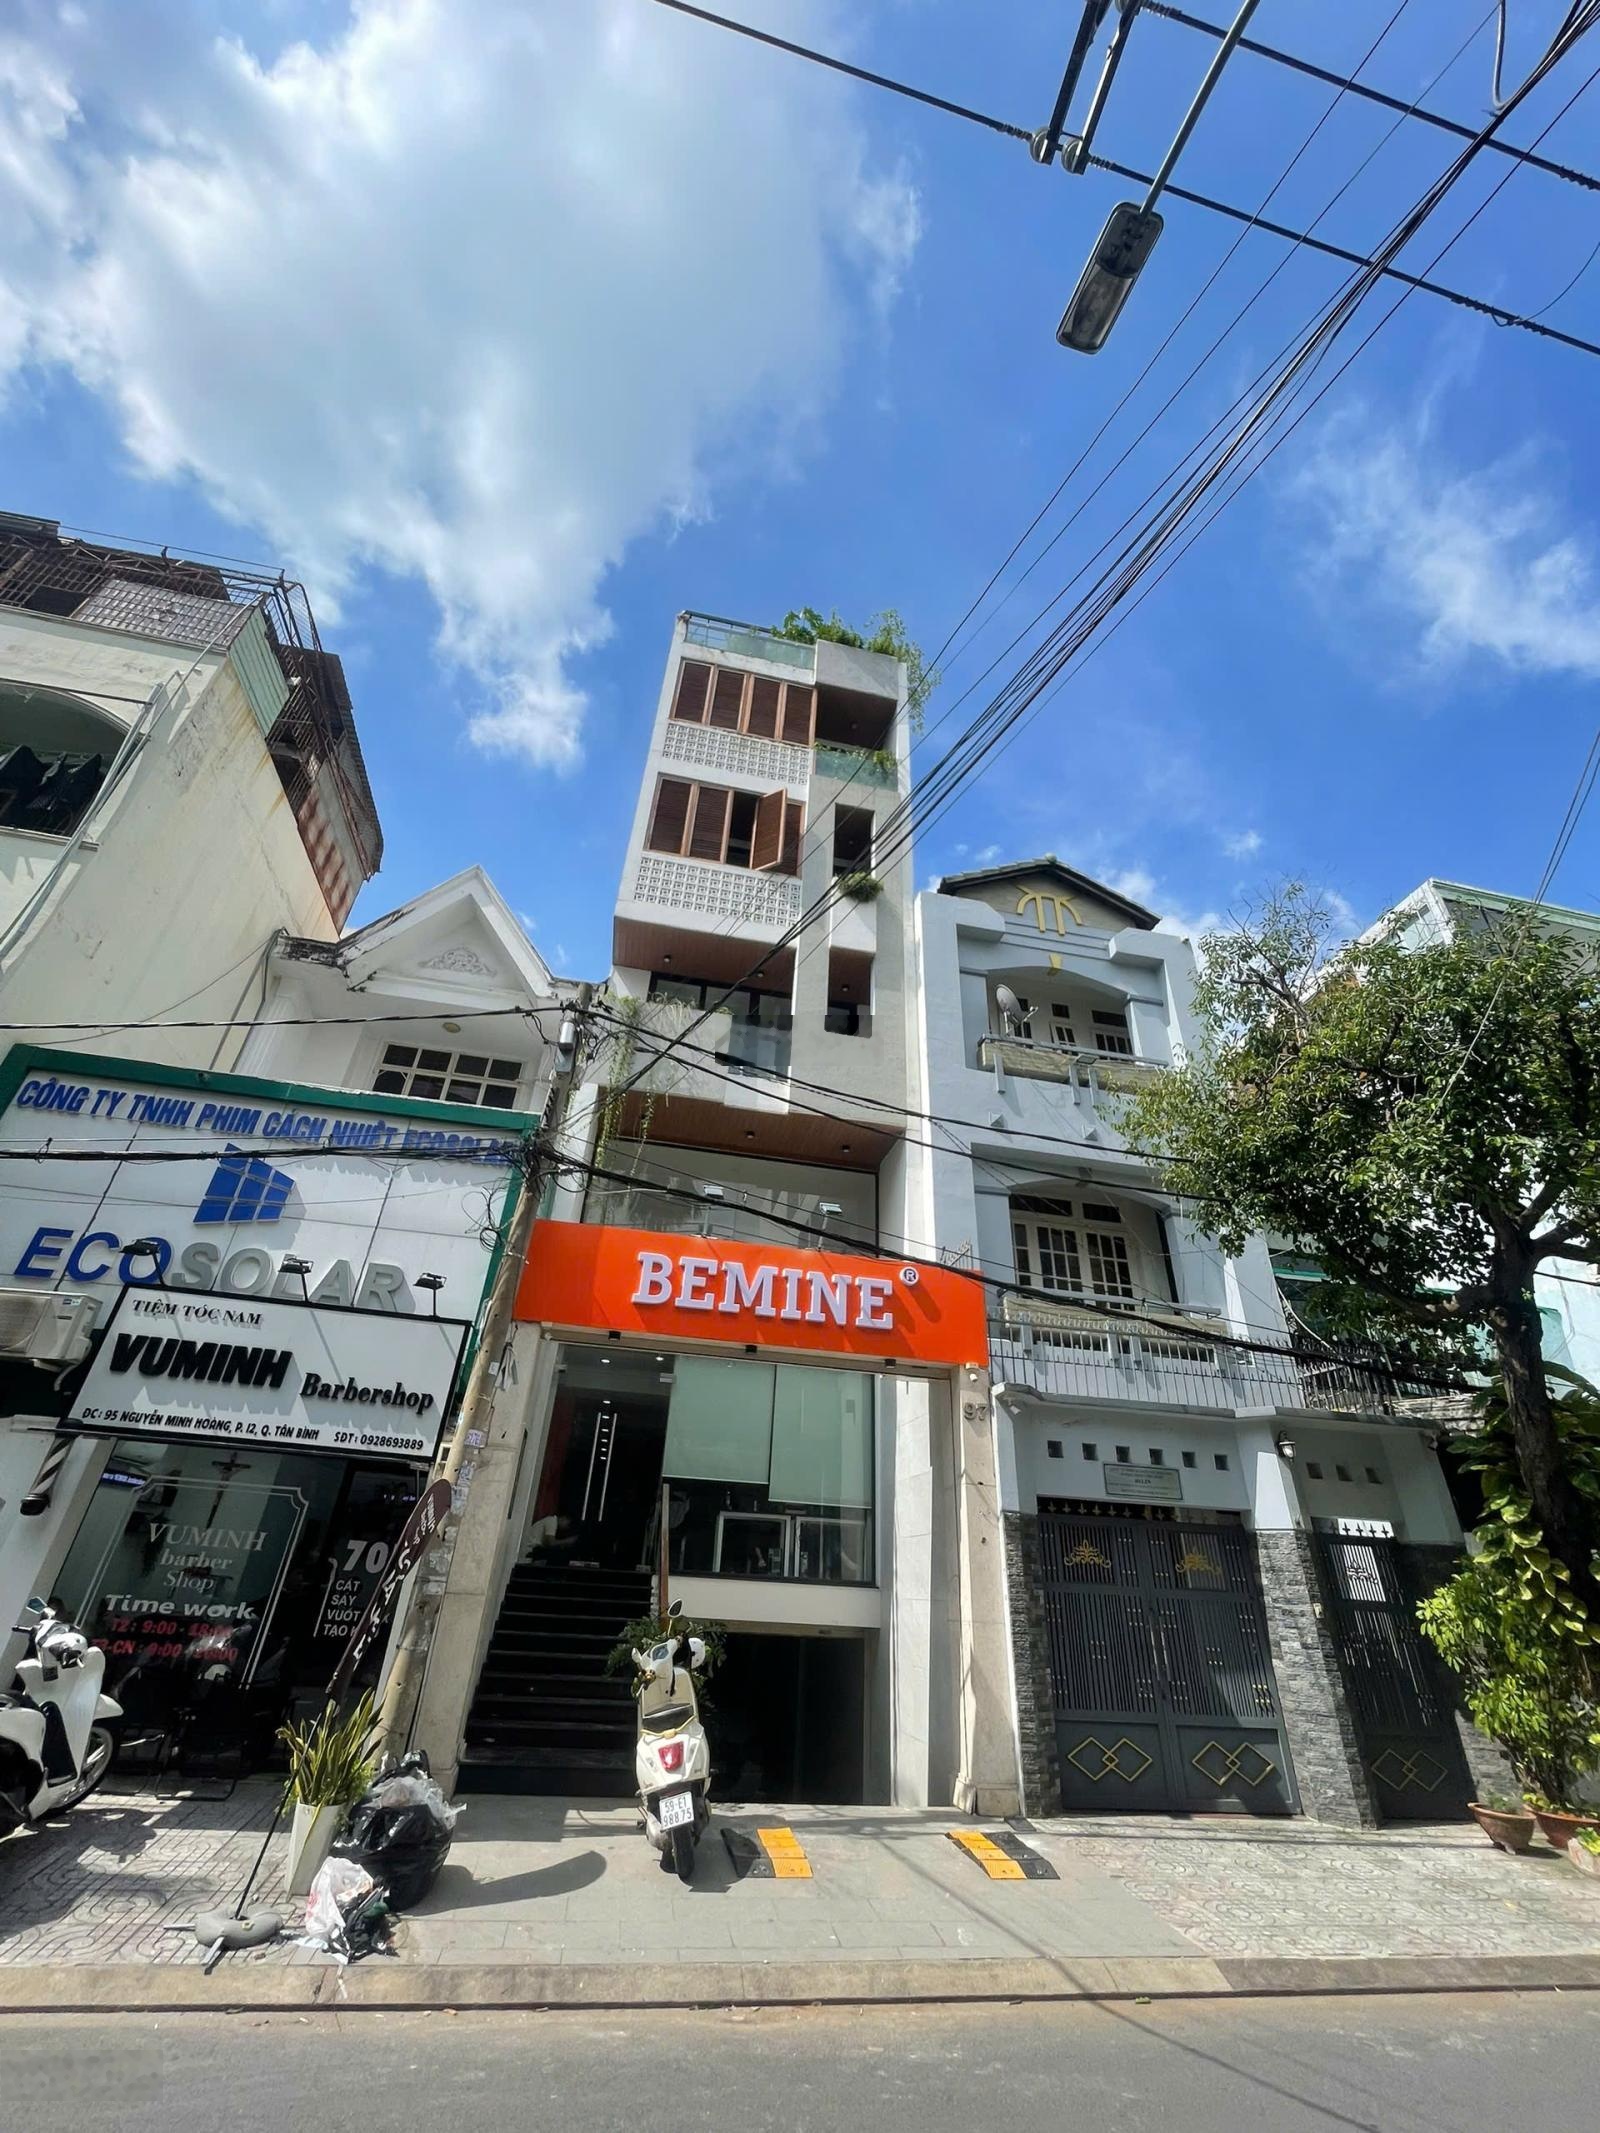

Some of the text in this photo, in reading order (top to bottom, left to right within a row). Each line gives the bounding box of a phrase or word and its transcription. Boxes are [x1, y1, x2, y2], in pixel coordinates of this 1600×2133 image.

[17, 1076, 90, 1112] CÔNG
[90, 1089, 127, 1116] TY
[127, 1094, 195, 1126] TNHH
[195, 1103, 262, 1135] PHIM
[631, 1250, 893, 1330] BEMINE
[132, 1298, 262, 1325] TIỆM TÓC NAM
[109, 1333, 293, 1389] VUMINH
[299, 1372, 434, 1415] Barbershop
[963, 1402, 987, 1421] 97
[103, 1409, 119, 1421] 95
[164, 1415, 193, 1428] MINH
[234, 1421, 243, 1433] P.
[261, 1424, 271, 1437] Q.
[274, 1424, 295, 1438] TÂN
[360, 1434, 424, 1450] 0928693889
[149, 1522, 269, 1551] VUMINH
[160, 1548, 233, 1569] barber
[342, 1539, 394, 1574] 70
[163, 1570, 215, 1593] Shop
[105, 1593, 256, 1620] Time work
[663, 1808, 692, 1827] 98875
